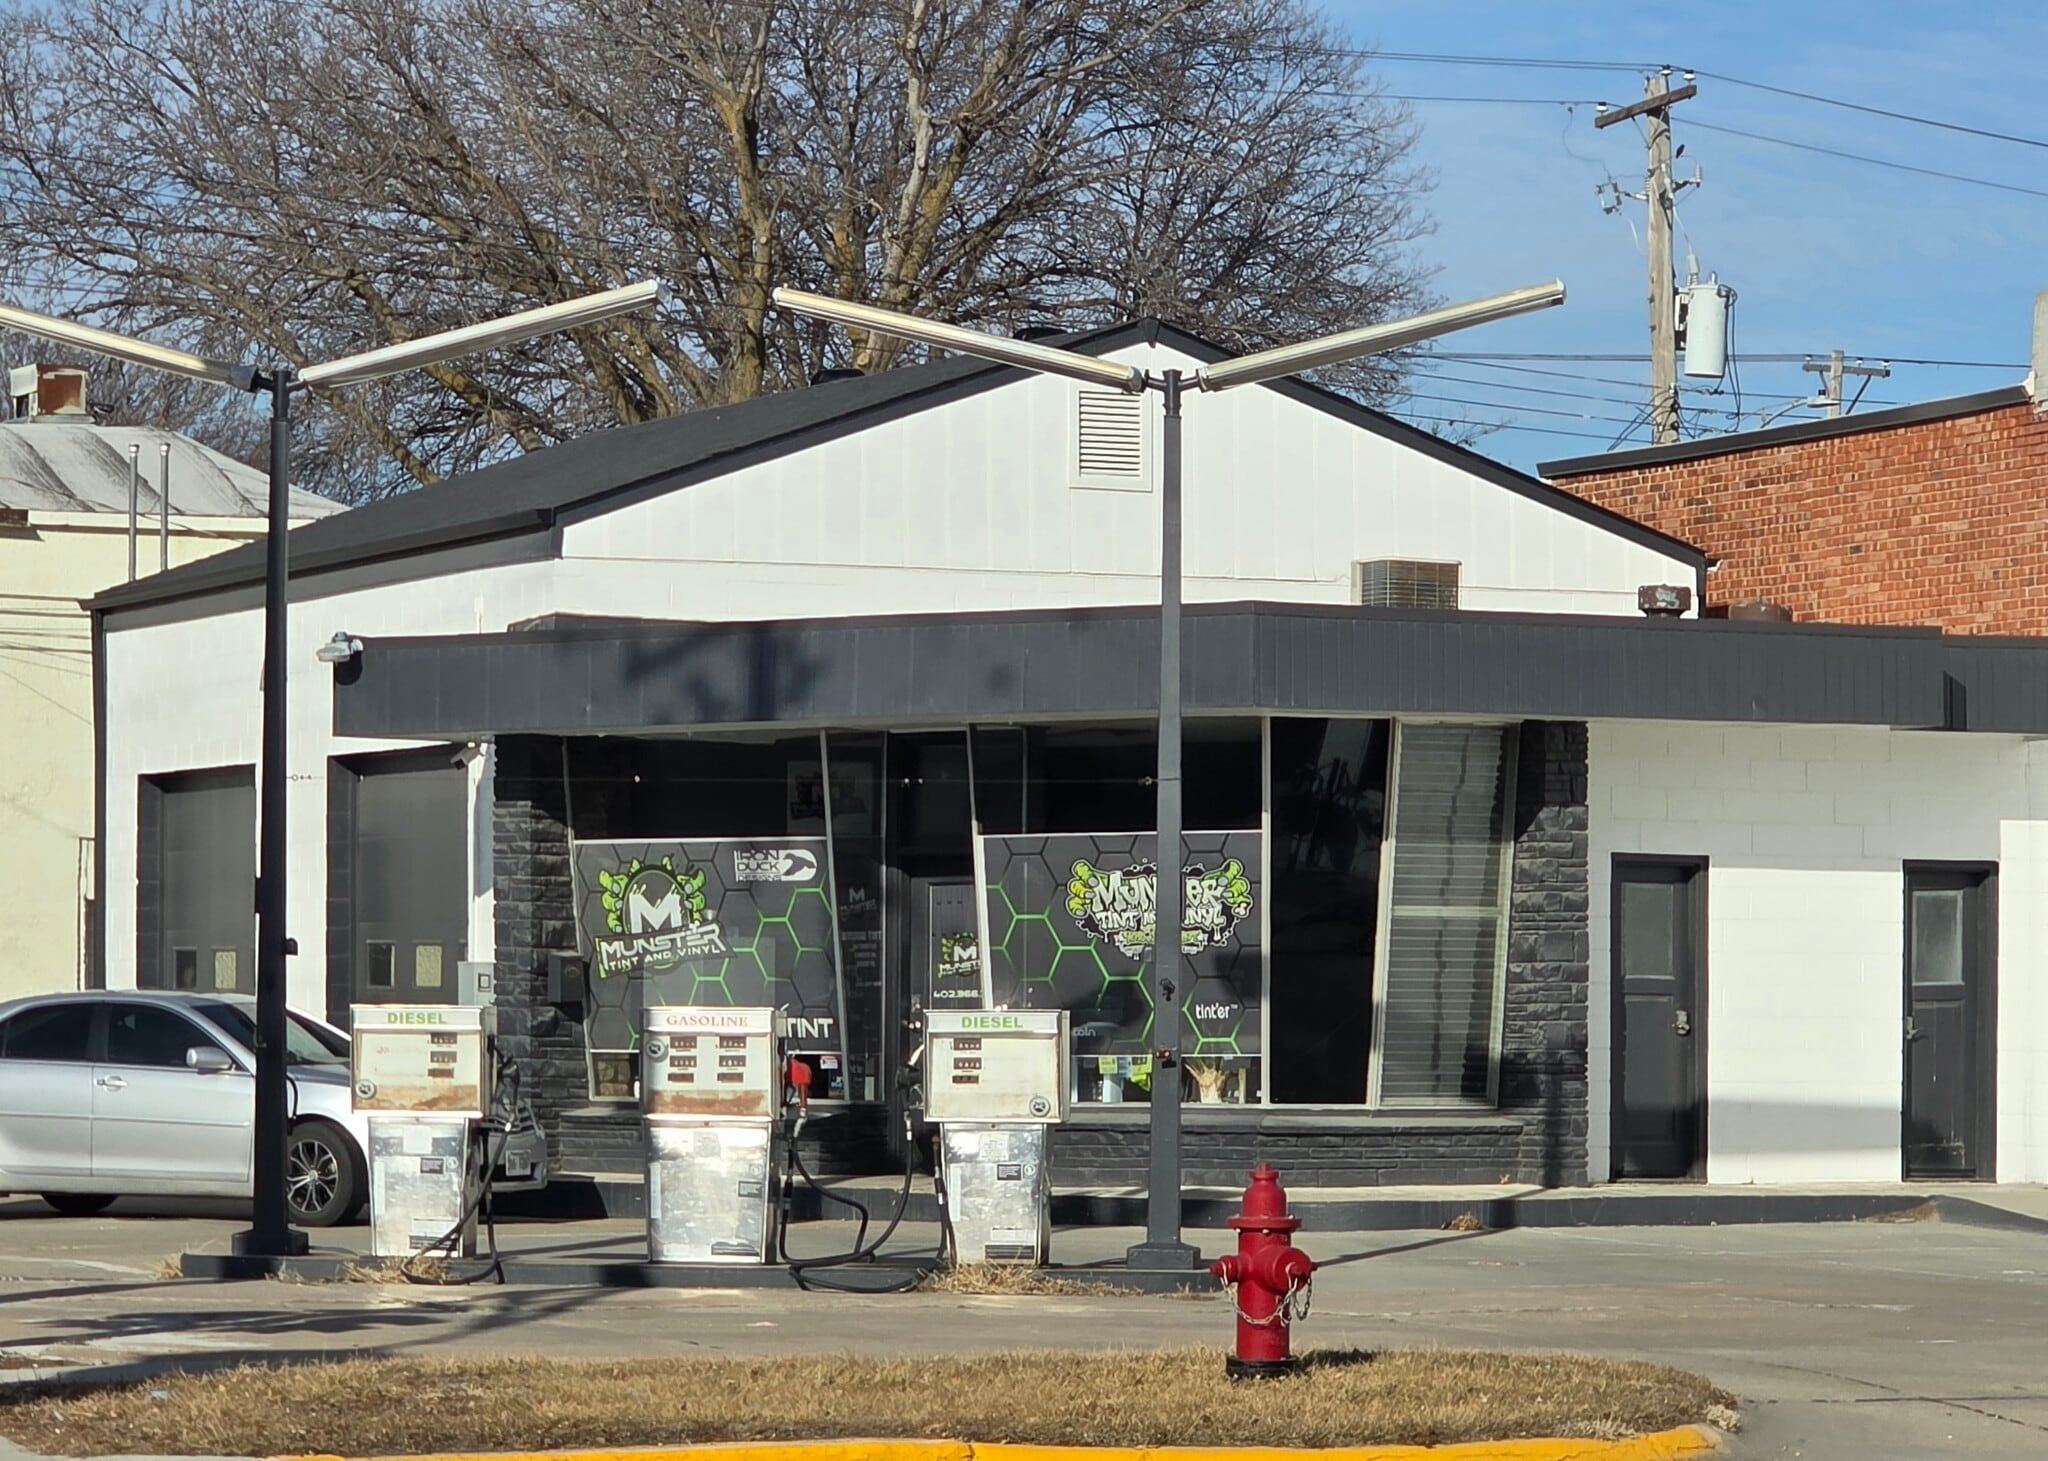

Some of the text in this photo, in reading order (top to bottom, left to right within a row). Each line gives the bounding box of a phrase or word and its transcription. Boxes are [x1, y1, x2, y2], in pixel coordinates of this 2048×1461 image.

[737, 862, 780, 872] DUCK
[629, 884, 682, 934] M
[1095, 911, 1139, 929] TINT
[600, 922, 727, 970] MUNSTER
[953, 945, 978, 962] M
[608, 945, 720, 971] TINT AND VINYL
[388, 1012, 447, 1024] DIESEL
[666, 1015, 748, 1027] GASOLINE
[961, 1016, 1023, 1028] DIESEL
[787, 1017, 834, 1038] TINT
